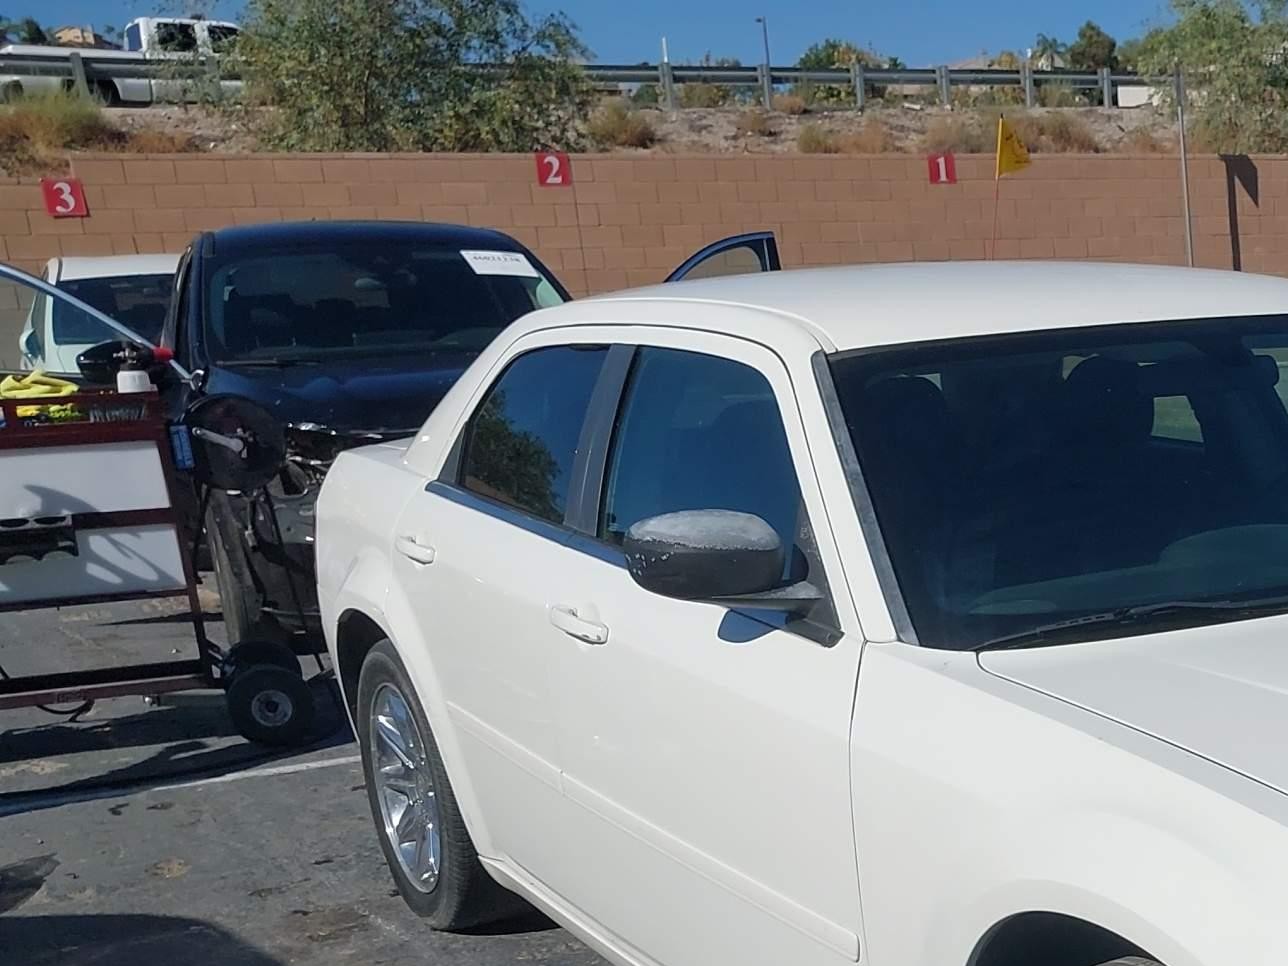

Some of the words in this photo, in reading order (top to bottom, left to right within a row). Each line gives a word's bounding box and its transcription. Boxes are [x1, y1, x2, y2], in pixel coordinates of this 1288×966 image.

[543, 155, 563, 184] 2
[936, 156, 949, 182] 1
[53, 182, 76, 213] 3
